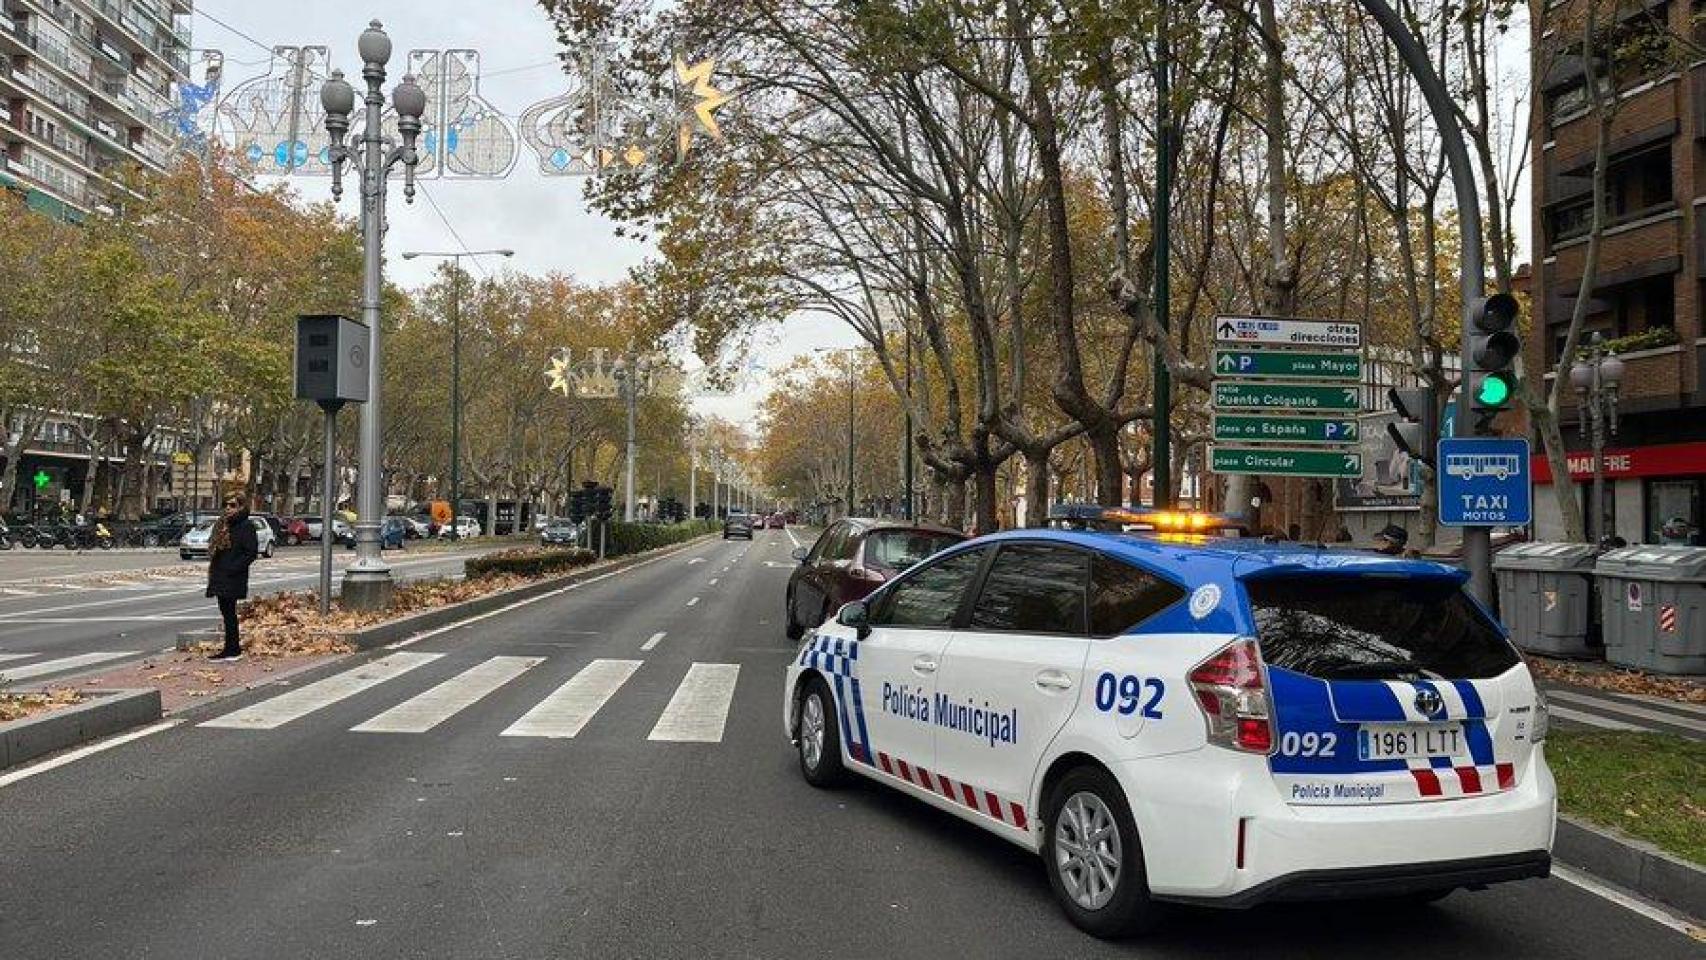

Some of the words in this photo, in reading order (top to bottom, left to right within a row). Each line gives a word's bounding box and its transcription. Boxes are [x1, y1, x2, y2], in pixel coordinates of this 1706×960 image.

[1327, 324, 1358, 334] otras
[1290, 331, 1358, 344] direcciones
[1239, 357, 1252, 370] P
[1292, 362, 1316, 371] plaza
[1320, 360, 1358, 372] Mayor
[1218, 394, 1260, 405] Puente
[1263, 395, 1318, 407] Colgante
[1216, 425, 1241, 434] plaza
[1245, 425, 1256, 433] de
[1261, 422, 1307, 434] España
[1325, 423, 1337, 437] P
[1214, 458, 1239, 467] plaza
[1244, 455, 1295, 467] Circular
[1461, 494, 1508, 509] TAXI
[1462, 511, 1506, 521] MOTOS
[1095, 671, 1165, 720] 092
[882, 682, 929, 722] Policía
[933, 693, 1017, 747] Municipal
[1282, 731, 1337, 757] 092
[1372, 732, 1419, 756] 1961
[1427, 730, 1459, 753] LTT
[1292, 784, 1330, 798] Policía
[1334, 783, 1385, 801] Municipal
